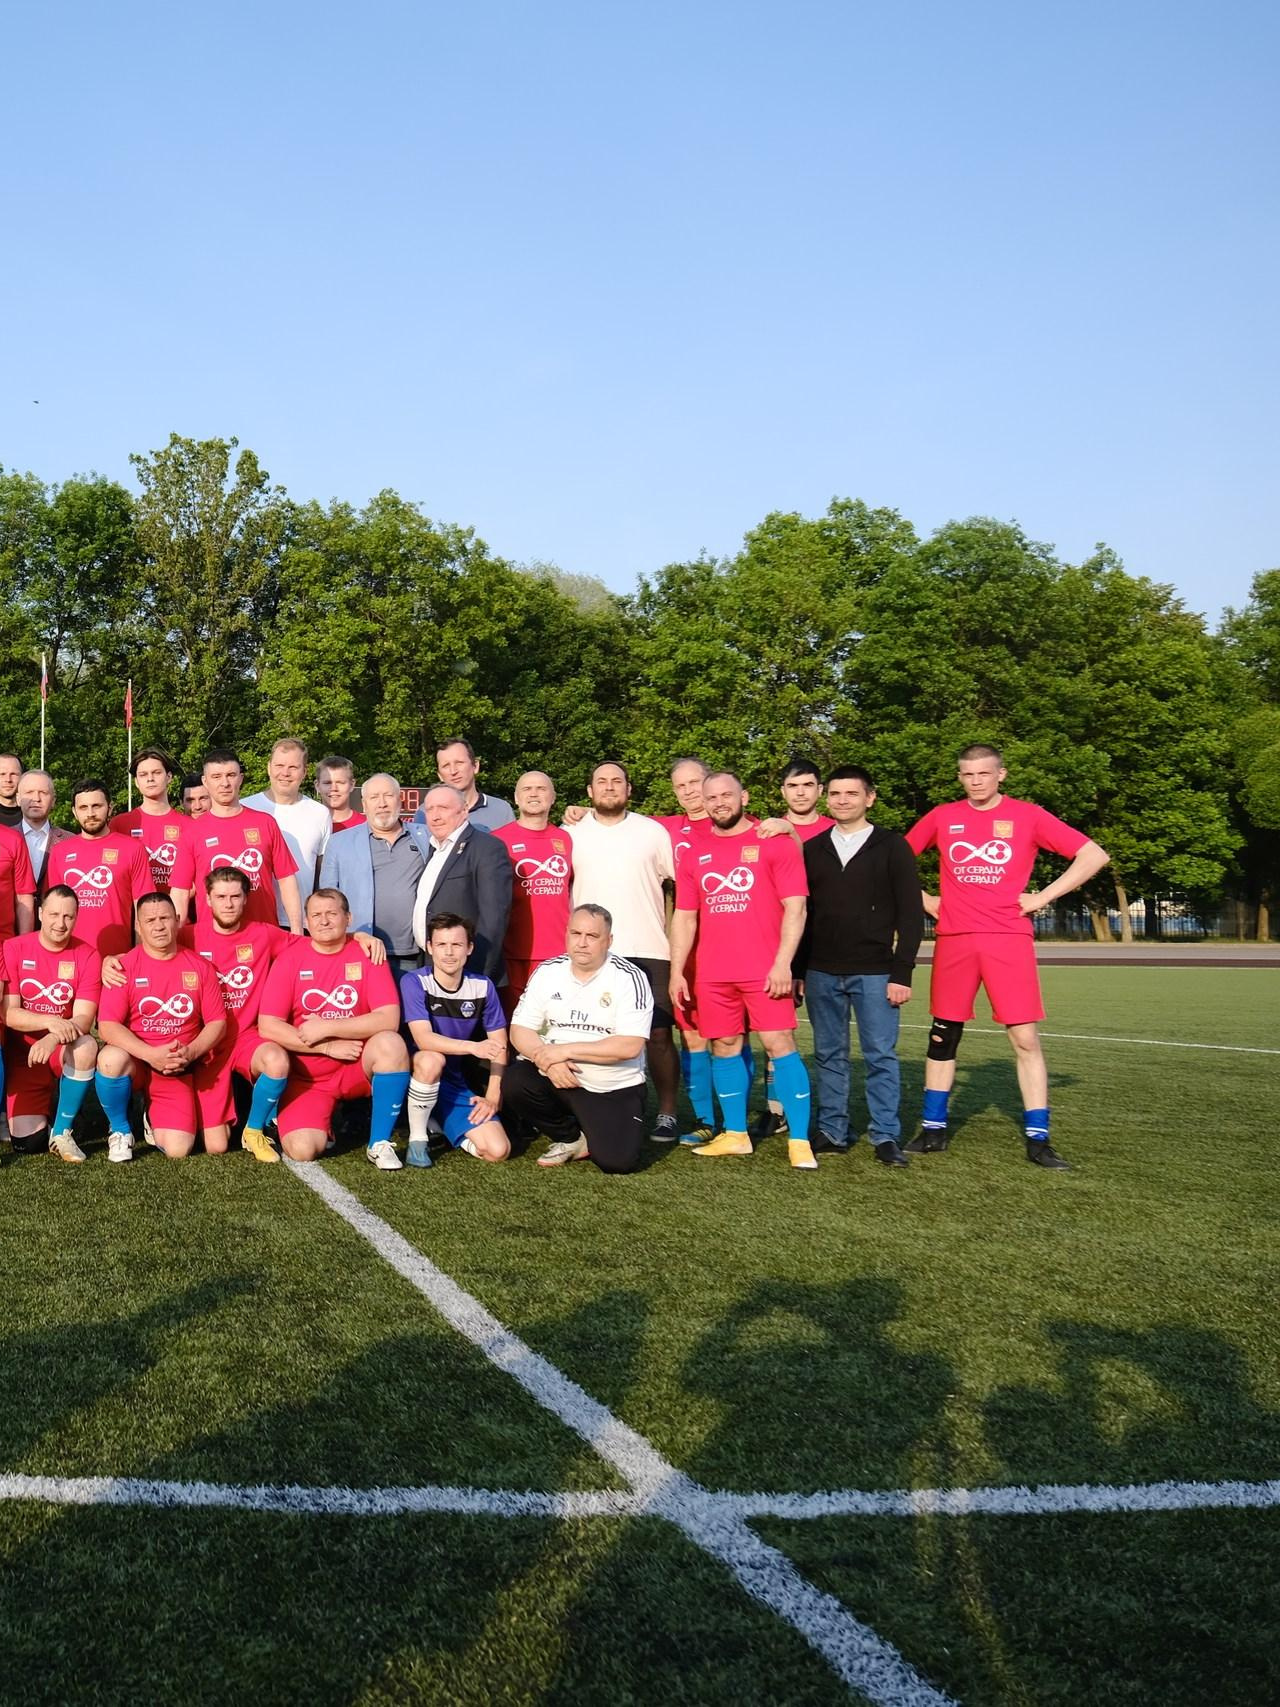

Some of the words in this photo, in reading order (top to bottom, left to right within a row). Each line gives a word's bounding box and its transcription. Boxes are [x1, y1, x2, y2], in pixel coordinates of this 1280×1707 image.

[967, 866, 1006, 875] СЕРДЦА
[521, 880, 533, 888] ОТ
[535, 878, 564, 886] СЕРДЦА
[964, 875, 1001, 884] СЕРДЦУ
[78, 889, 108, 897] СЕРДЦА
[533, 887, 562, 895] СЕРДЦУ
[706, 896, 716, 904] ОТ
[717, 893, 751, 902] СЕРДЦА
[715, 903, 747, 913] СЕРДЦУ
[222, 990, 248, 1000] ЕРДЦА
[35, 1003, 66, 1013] СЕРДЦА
[225, 999, 245, 1009] РДЦУ
[321, 1010, 354, 1019] СЕРДЦА
[570, 1010, 589, 1022] Fly
